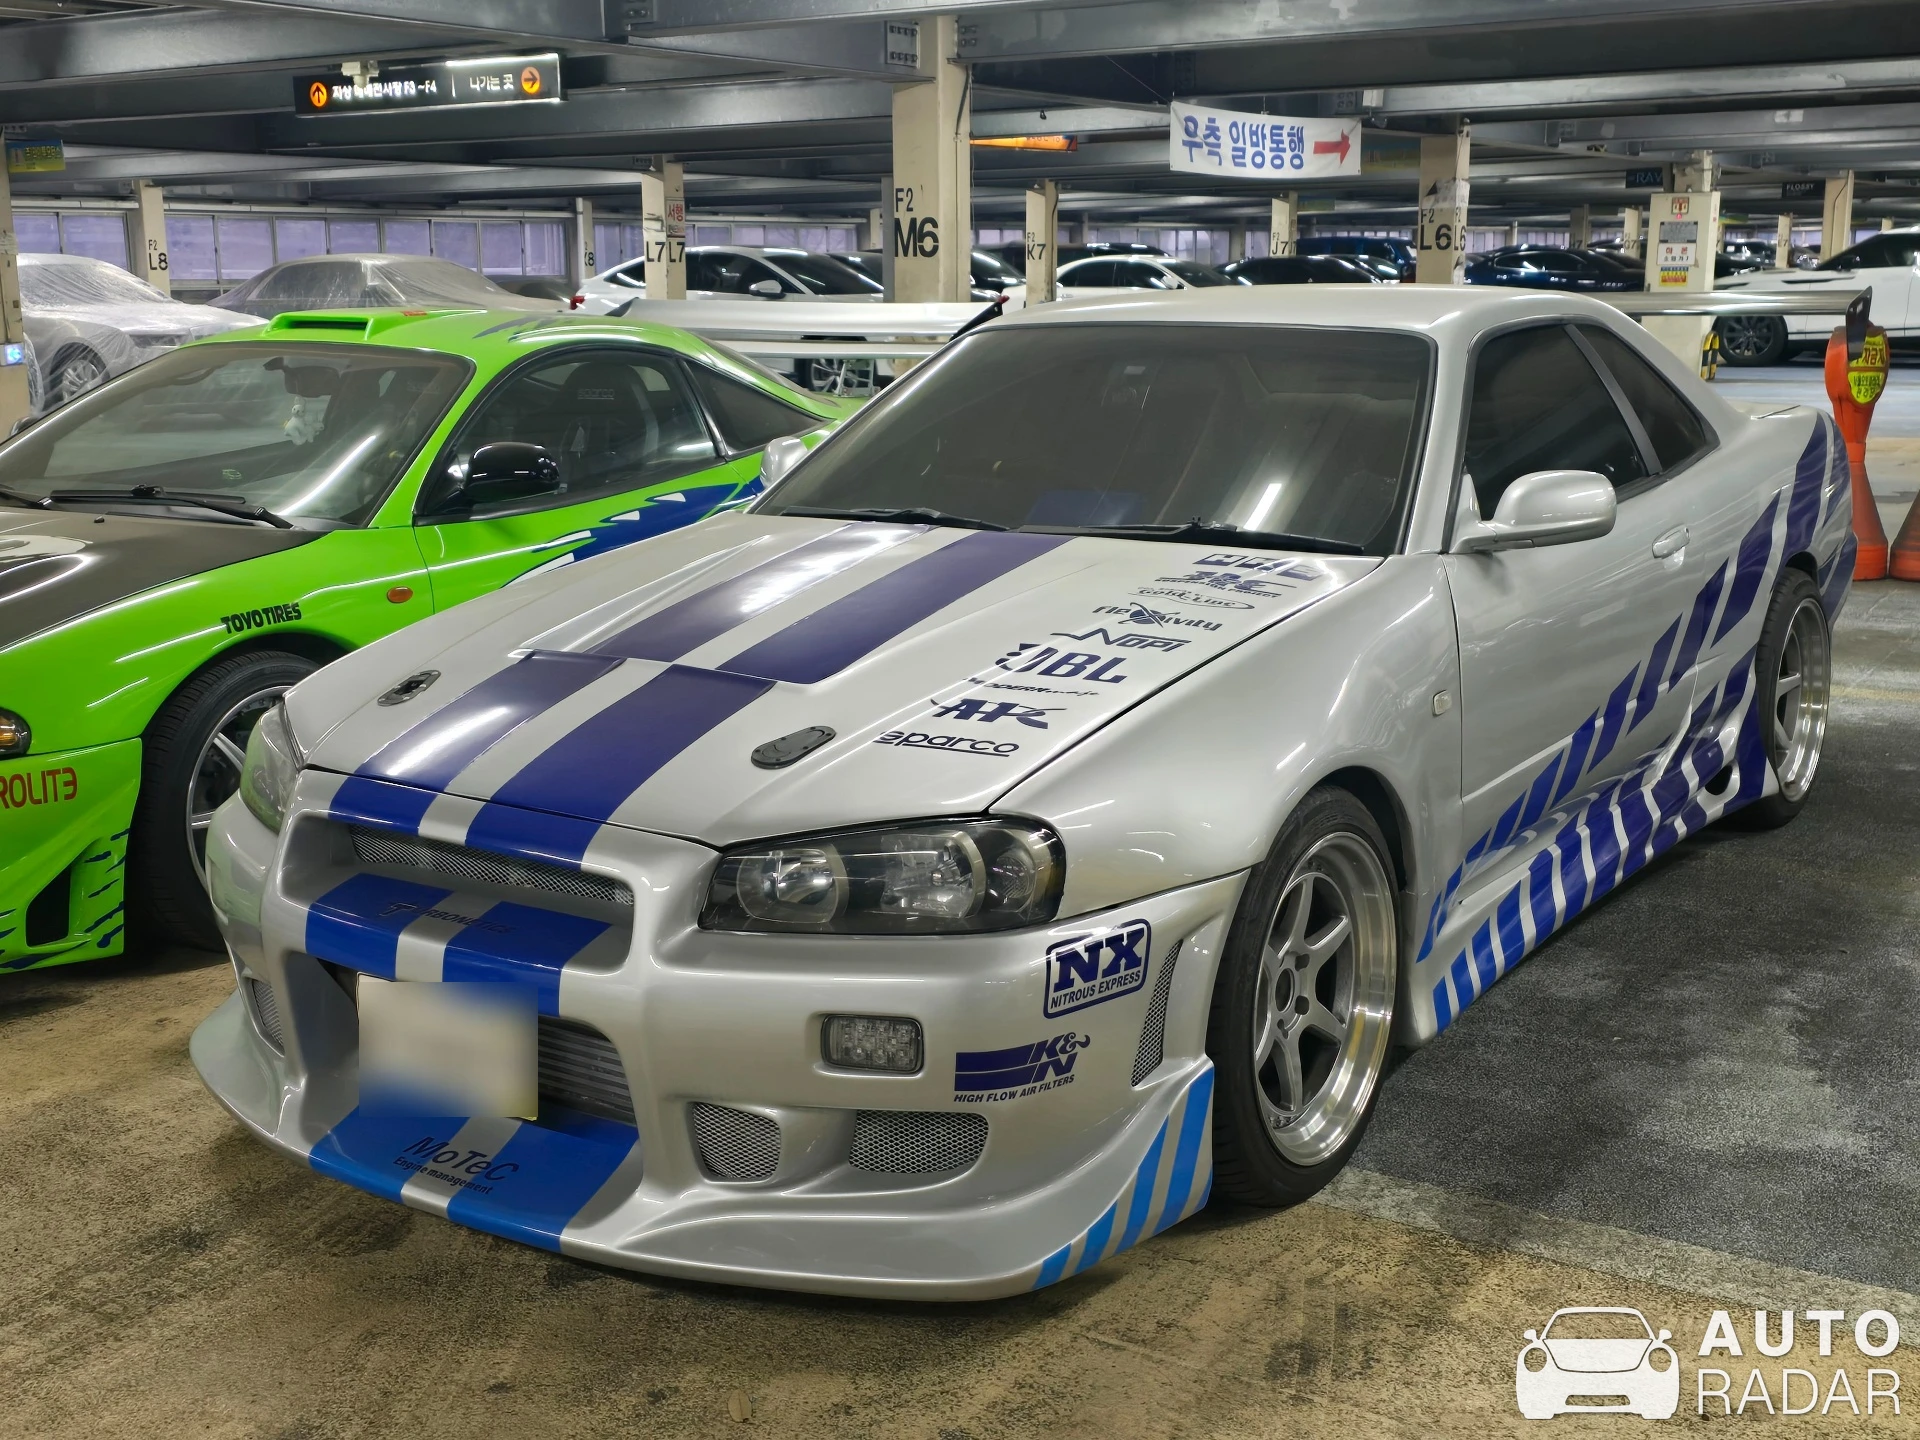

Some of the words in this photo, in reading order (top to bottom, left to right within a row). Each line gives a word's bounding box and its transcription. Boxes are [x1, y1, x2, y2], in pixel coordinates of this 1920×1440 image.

[404, 81, 415, 95] F3
[469, 75, 500, 92] 나가는
[501, 74, 514, 90] 곳
[1182, 115, 1223, 166] 우측
[1229, 121, 1305, 170] 일방통행
[895, 188, 913, 212] F2
[668, 203, 684, 222] 서행
[1421, 209, 1434, 223] F2
[148, 239, 157, 250] F2
[894, 216, 939, 258] M6
[1027, 232, 1035, 242] F2
[1272, 241, 1288, 255] J7
[1420, 224, 1452, 250] L6
[1454, 225, 1466, 251] L6
[149, 252, 168, 270] L8
[646, 241, 665, 262] L7
[669, 241, 685, 262] L7
[1027, 243, 1046, 260] K7
[995, 643, 1127, 683] JBL
[873, 731, 1020, 756] sparco
[1054, 927, 1145, 993] NX
[1051, 985, 1095, 1009] NITROUS
[1098, 970, 1141, 994] EXPRESS
[1029, 1032, 1091, 1083] K&N
[954, 1094, 984, 1103] HIGH
[986, 1091, 1018, 1102] FLOW
[1020, 1086, 1036, 1097] AIR
[1038, 1074, 1075, 1093] FILTERS
[403, 1137, 519, 1181] MoTeC
[393, 1156, 428, 1174] Engine
[427, 1169, 493, 1195] management
